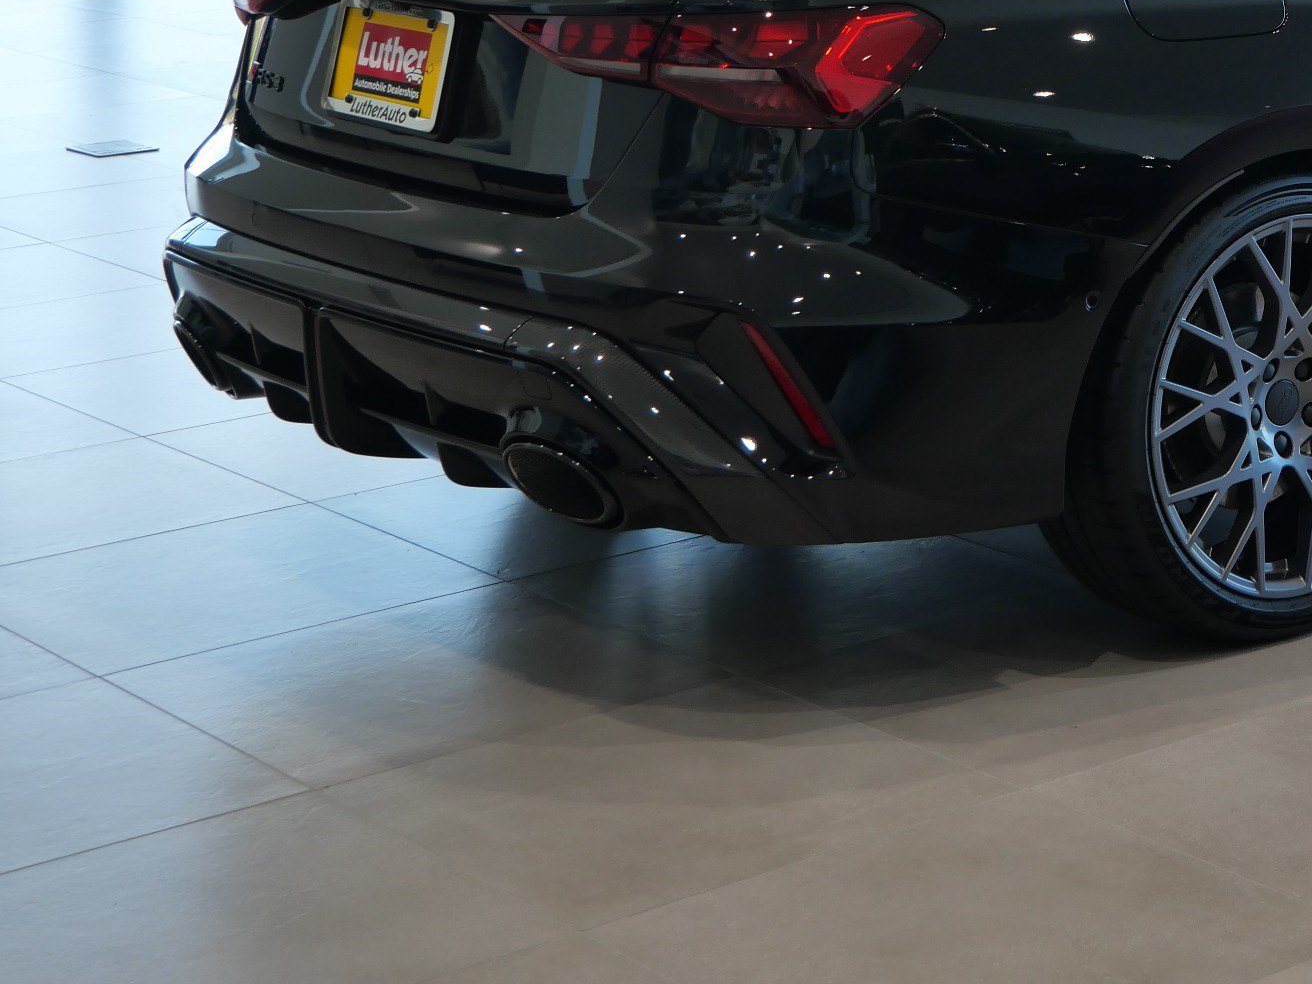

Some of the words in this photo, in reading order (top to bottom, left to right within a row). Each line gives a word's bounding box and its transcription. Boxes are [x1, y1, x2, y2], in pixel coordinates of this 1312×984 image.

[357, 31, 429, 74] Luther
[354, 77, 387, 93] Automobile
[386, 82, 419, 100] Dealerships
[349, 96, 407, 123] LutherAuto
